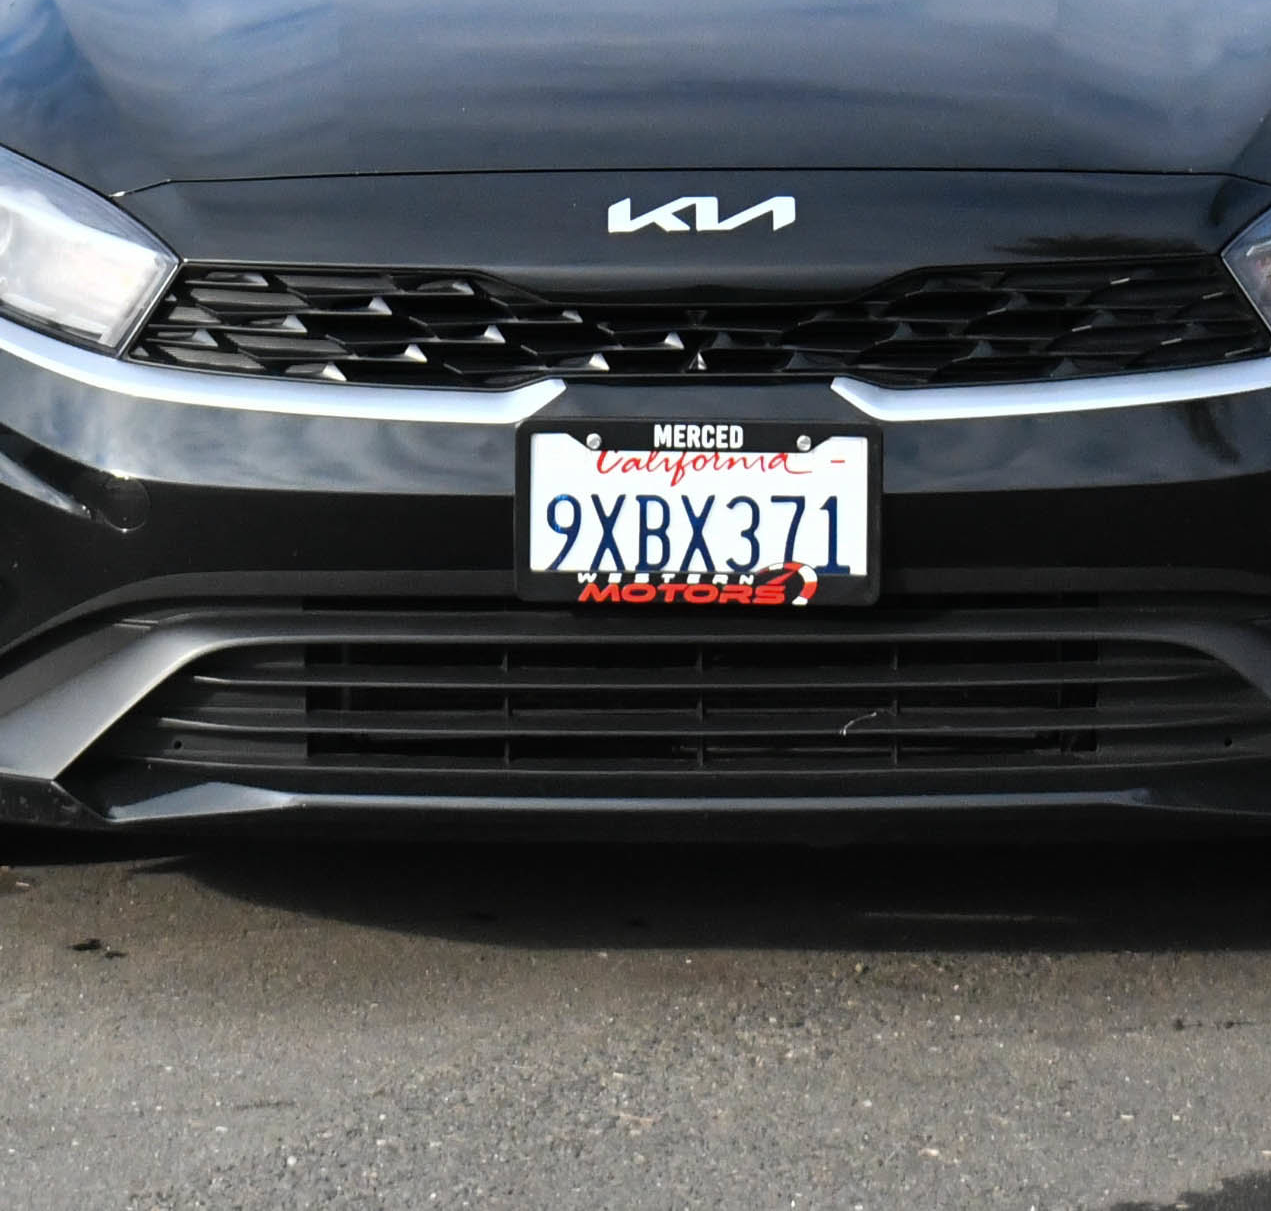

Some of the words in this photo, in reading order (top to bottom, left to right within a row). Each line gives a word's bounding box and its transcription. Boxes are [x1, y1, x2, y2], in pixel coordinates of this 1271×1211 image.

[653, 424, 744, 449] MERCED
[596, 449, 813, 487] California
[545, 494, 851, 574] 9XBX371
[577, 572, 754, 585] WESTERN
[578, 582, 786, 605] MOTORS
